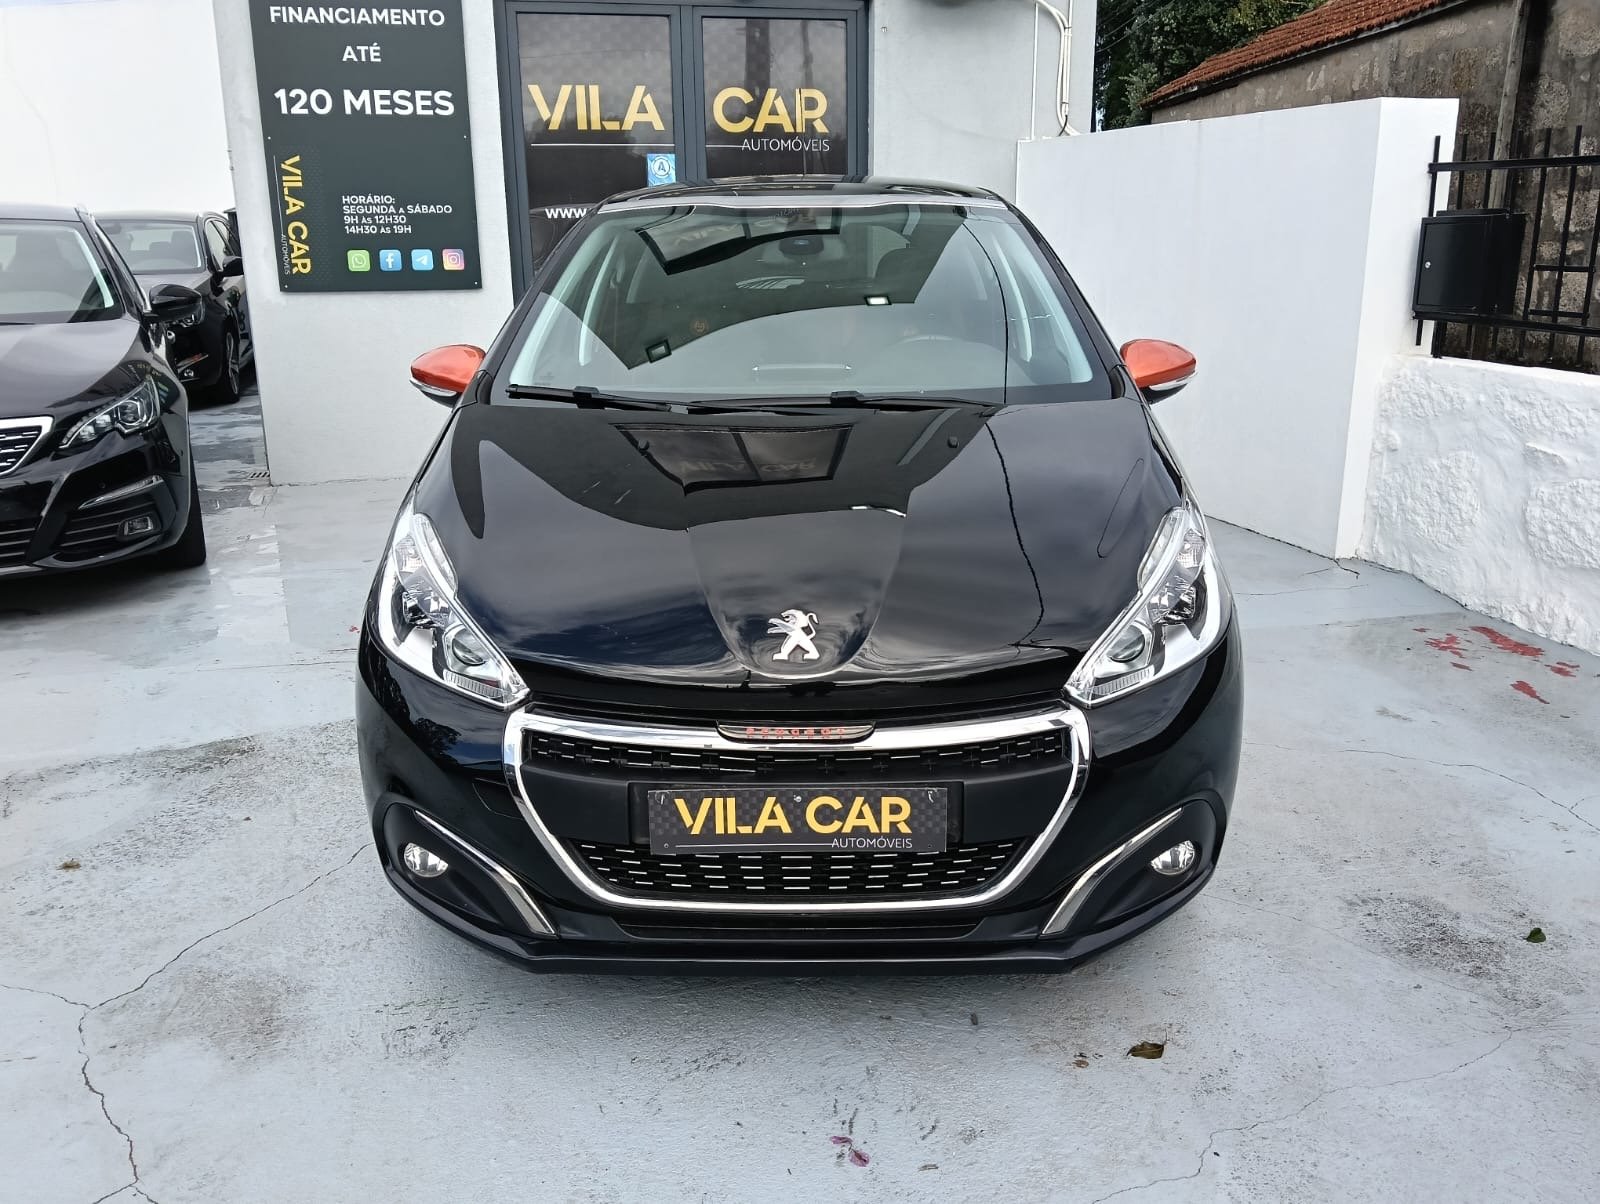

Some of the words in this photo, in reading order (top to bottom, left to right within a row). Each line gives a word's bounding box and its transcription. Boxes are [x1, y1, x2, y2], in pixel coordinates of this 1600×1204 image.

[269, 6, 445, 27] FINANCIAMENTO
[342, 42, 381, 62] ATÉ
[274, 88, 333, 115] 120
[343, 89, 455, 116] MESES
[527, 84, 665, 131] VILA
[712, 87, 829, 133] CAR
[741, 136, 830, 152] AUTOMÓVEIS
[281, 155, 305, 215] VILA
[342, 194, 395, 204] HORÁRIO:
[342, 205, 396, 214] SEGUNDA
[407, 203, 453, 214] SÁBADO
[344, 215, 359, 224] 9H
[374, 215, 407, 224] 12H30
[344, 225, 378, 234] 14H30
[393, 225, 412, 234] 19H
[287, 221, 312, 274] CAR
[674, 797, 792, 834] VILA
[805, 796, 912, 833] CAR
[831, 837, 913, 849] AUTOMÓVEIS
